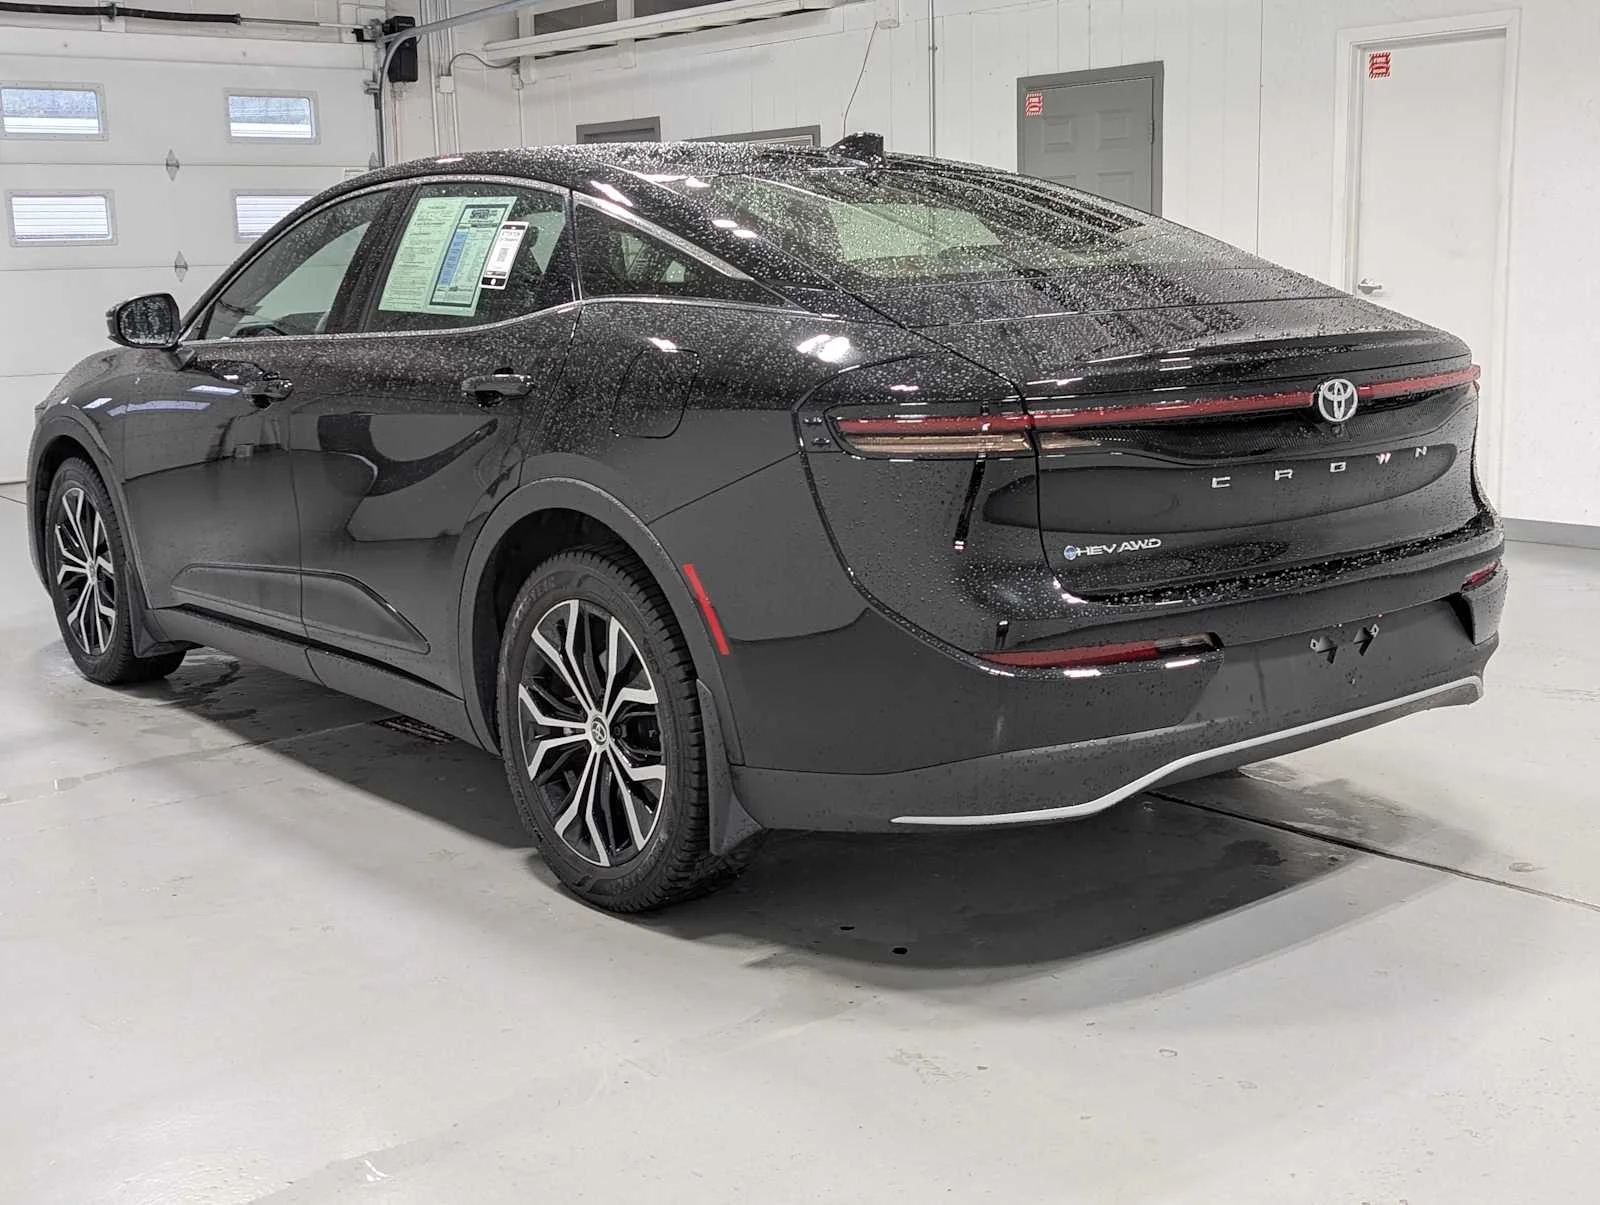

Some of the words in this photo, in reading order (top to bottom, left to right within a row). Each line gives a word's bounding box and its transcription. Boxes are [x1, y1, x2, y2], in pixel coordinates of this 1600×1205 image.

[1211, 446, 1428, 489] CROWN
[1076, 543, 1117, 557] HEV
[1117, 538, 1162, 553] AWD
